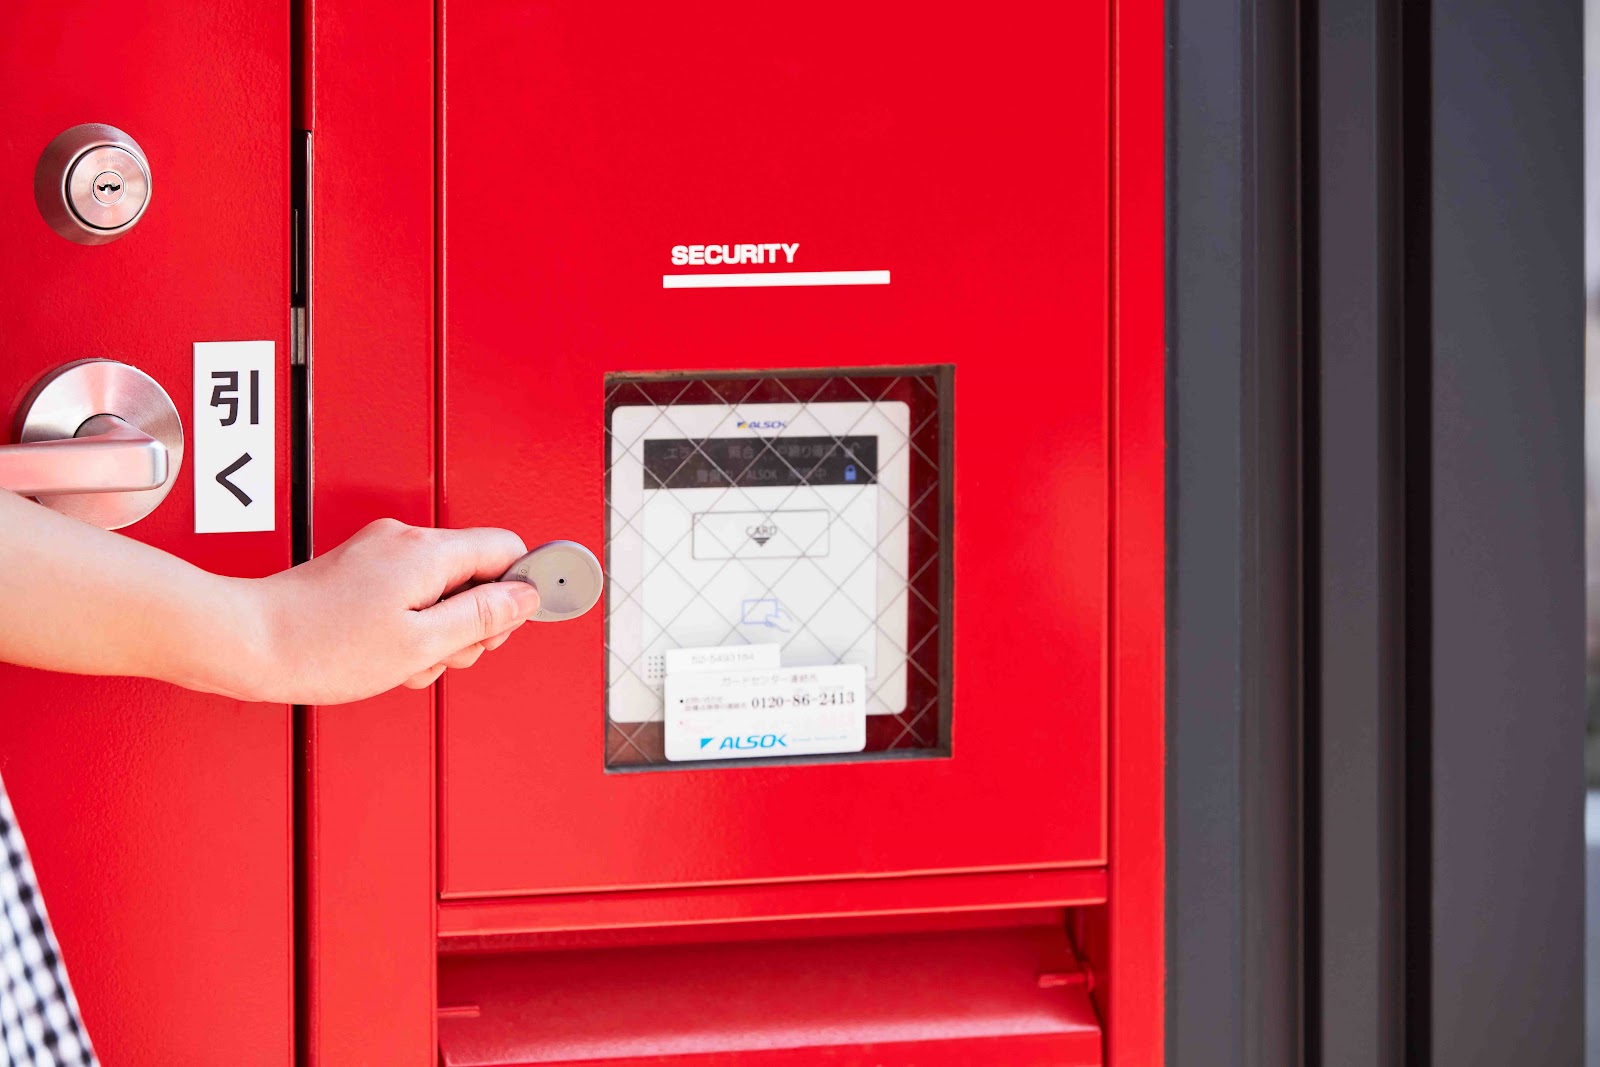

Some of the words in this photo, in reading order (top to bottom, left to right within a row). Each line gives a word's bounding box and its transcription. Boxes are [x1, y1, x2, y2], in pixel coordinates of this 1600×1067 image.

[671, 243, 799, 265] SECURITY
[210, 370, 259, 507] 引く
[745, 525, 778, 537] CARD
[751, 692, 856, 709] 0120-86-2413
[719, 734, 788, 750] ALSOK
